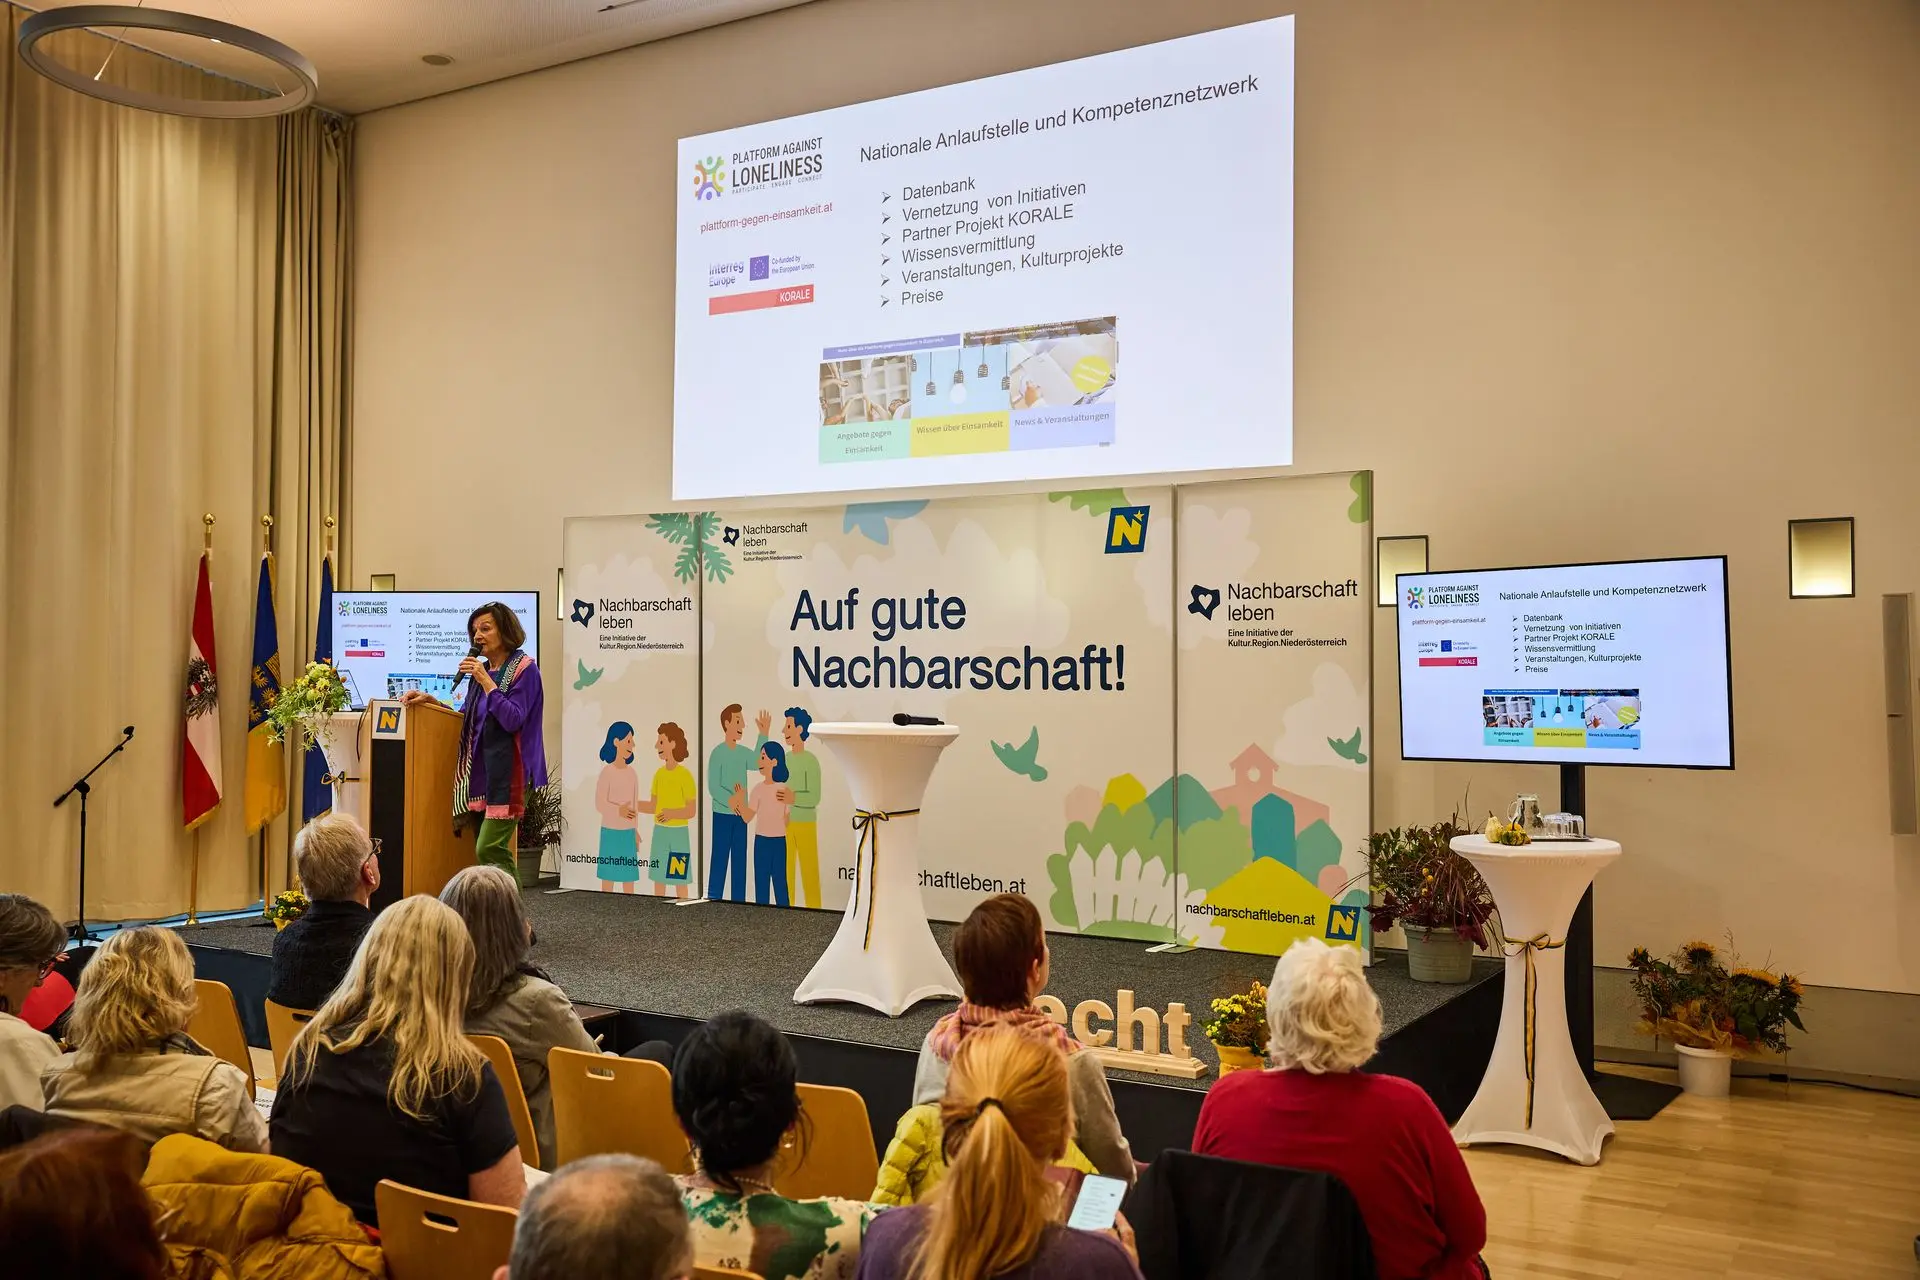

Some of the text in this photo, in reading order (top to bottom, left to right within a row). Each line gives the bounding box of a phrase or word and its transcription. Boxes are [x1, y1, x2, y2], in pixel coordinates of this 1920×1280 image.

[860, 75, 1259, 162] Nationale Anlaufstelle und Kompetenznetzwerk
[732, 136, 823, 165] PLATFORM AGAINST
[732, 153, 823, 188] LONELINESS
[903, 176, 976, 201] Datenbank
[902, 181, 1086, 222] Vernetzung von Initiativen
[700, 202, 833, 235] plattform-gegen-einsamkeit.at
[902, 203, 1074, 243] Partner Projekt KORALE
[902, 233, 1035, 264] Wissensvermittlung
[709, 261, 745, 276] Interreg
[901, 242, 1124, 285] Veranstaltungen, Kulturprojekte
[709, 275, 736, 288] Europe
[779, 288, 811, 303] KORALE
[901, 288, 944, 306] Preise
[1014, 411, 1110, 427] News & Veranstaltungen
[916, 420, 1004, 434] Wissen über Einsamkeit
[837, 429, 892, 441] Angebote gegen
[845, 444, 883, 454] Einsamkeit
[742, 522, 808, 535] Nachbarschaft
[742, 537, 767, 547] leben
[1227, 579, 1358, 601] Nachbarschaft
[1428, 584, 1479, 593] PLATFORM AGAINST
[1499, 583, 1707, 600] Nationale Anlaufstelle und Kompetenznetzwerk
[599, 596, 692, 612] Nachbarschaft
[1428, 592, 1480, 605] LONELINESS
[352, 606, 388, 615] LONELINESS
[789, 588, 967, 642] Auf gute
[1227, 604, 1274, 622] leben
[1523, 613, 1563, 622] Datenbank
[599, 615, 633, 629] leben
[1524, 624, 1565, 633] Vernetzung
[1585, 622, 1621, 631] Initiativen
[1228, 628, 1294, 637] Eine Initiative der
[1524, 632, 1615, 643] Partner Projekt KORALE
[1228, 638, 1347, 649] Kultur.Region.Niederösterreich
[1524, 643, 1596, 653] Wissensvermittlung
[1525, 653, 1642, 664] Veranstaltungen, Kulturprojekte
[791, 644, 1126, 691] Nachbarschaft!
[1525, 665, 1549, 673] Preise
[566, 853, 660, 869] nachbarschaftleben.at
[838, 866, 1027, 895] nahaftleben.at
[1185, 903, 1316, 926] nachbarschaftleben.at
